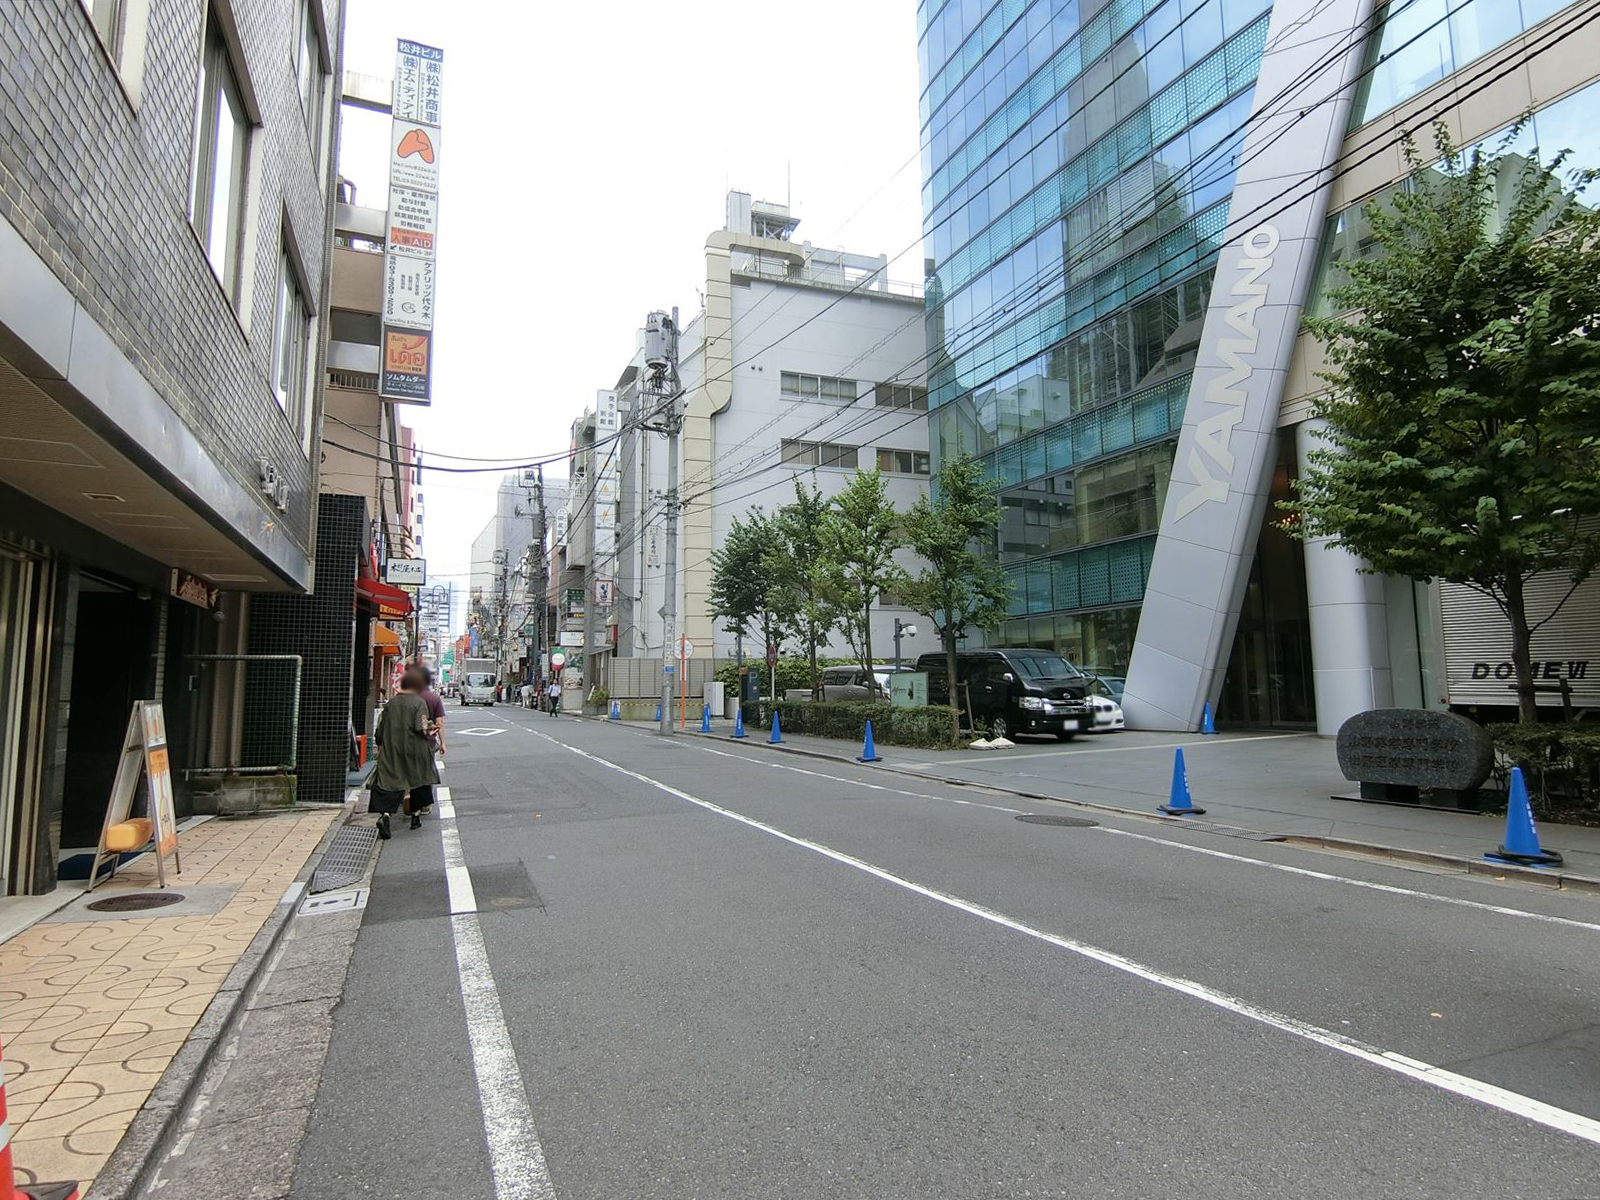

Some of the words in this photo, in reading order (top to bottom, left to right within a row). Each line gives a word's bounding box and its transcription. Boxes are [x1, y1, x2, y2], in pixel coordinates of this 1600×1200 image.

[400, 42, 441, 60] 松井ビル
[426, 61, 441, 123] (株)松井商事
[422, 262, 433, 319] ケアリッツ代々木
[386, 373, 426, 382] ソムタムダー
[1174, 224, 1281, 524] YAMANO
[391, 562, 424, 574] 木村屋本店
